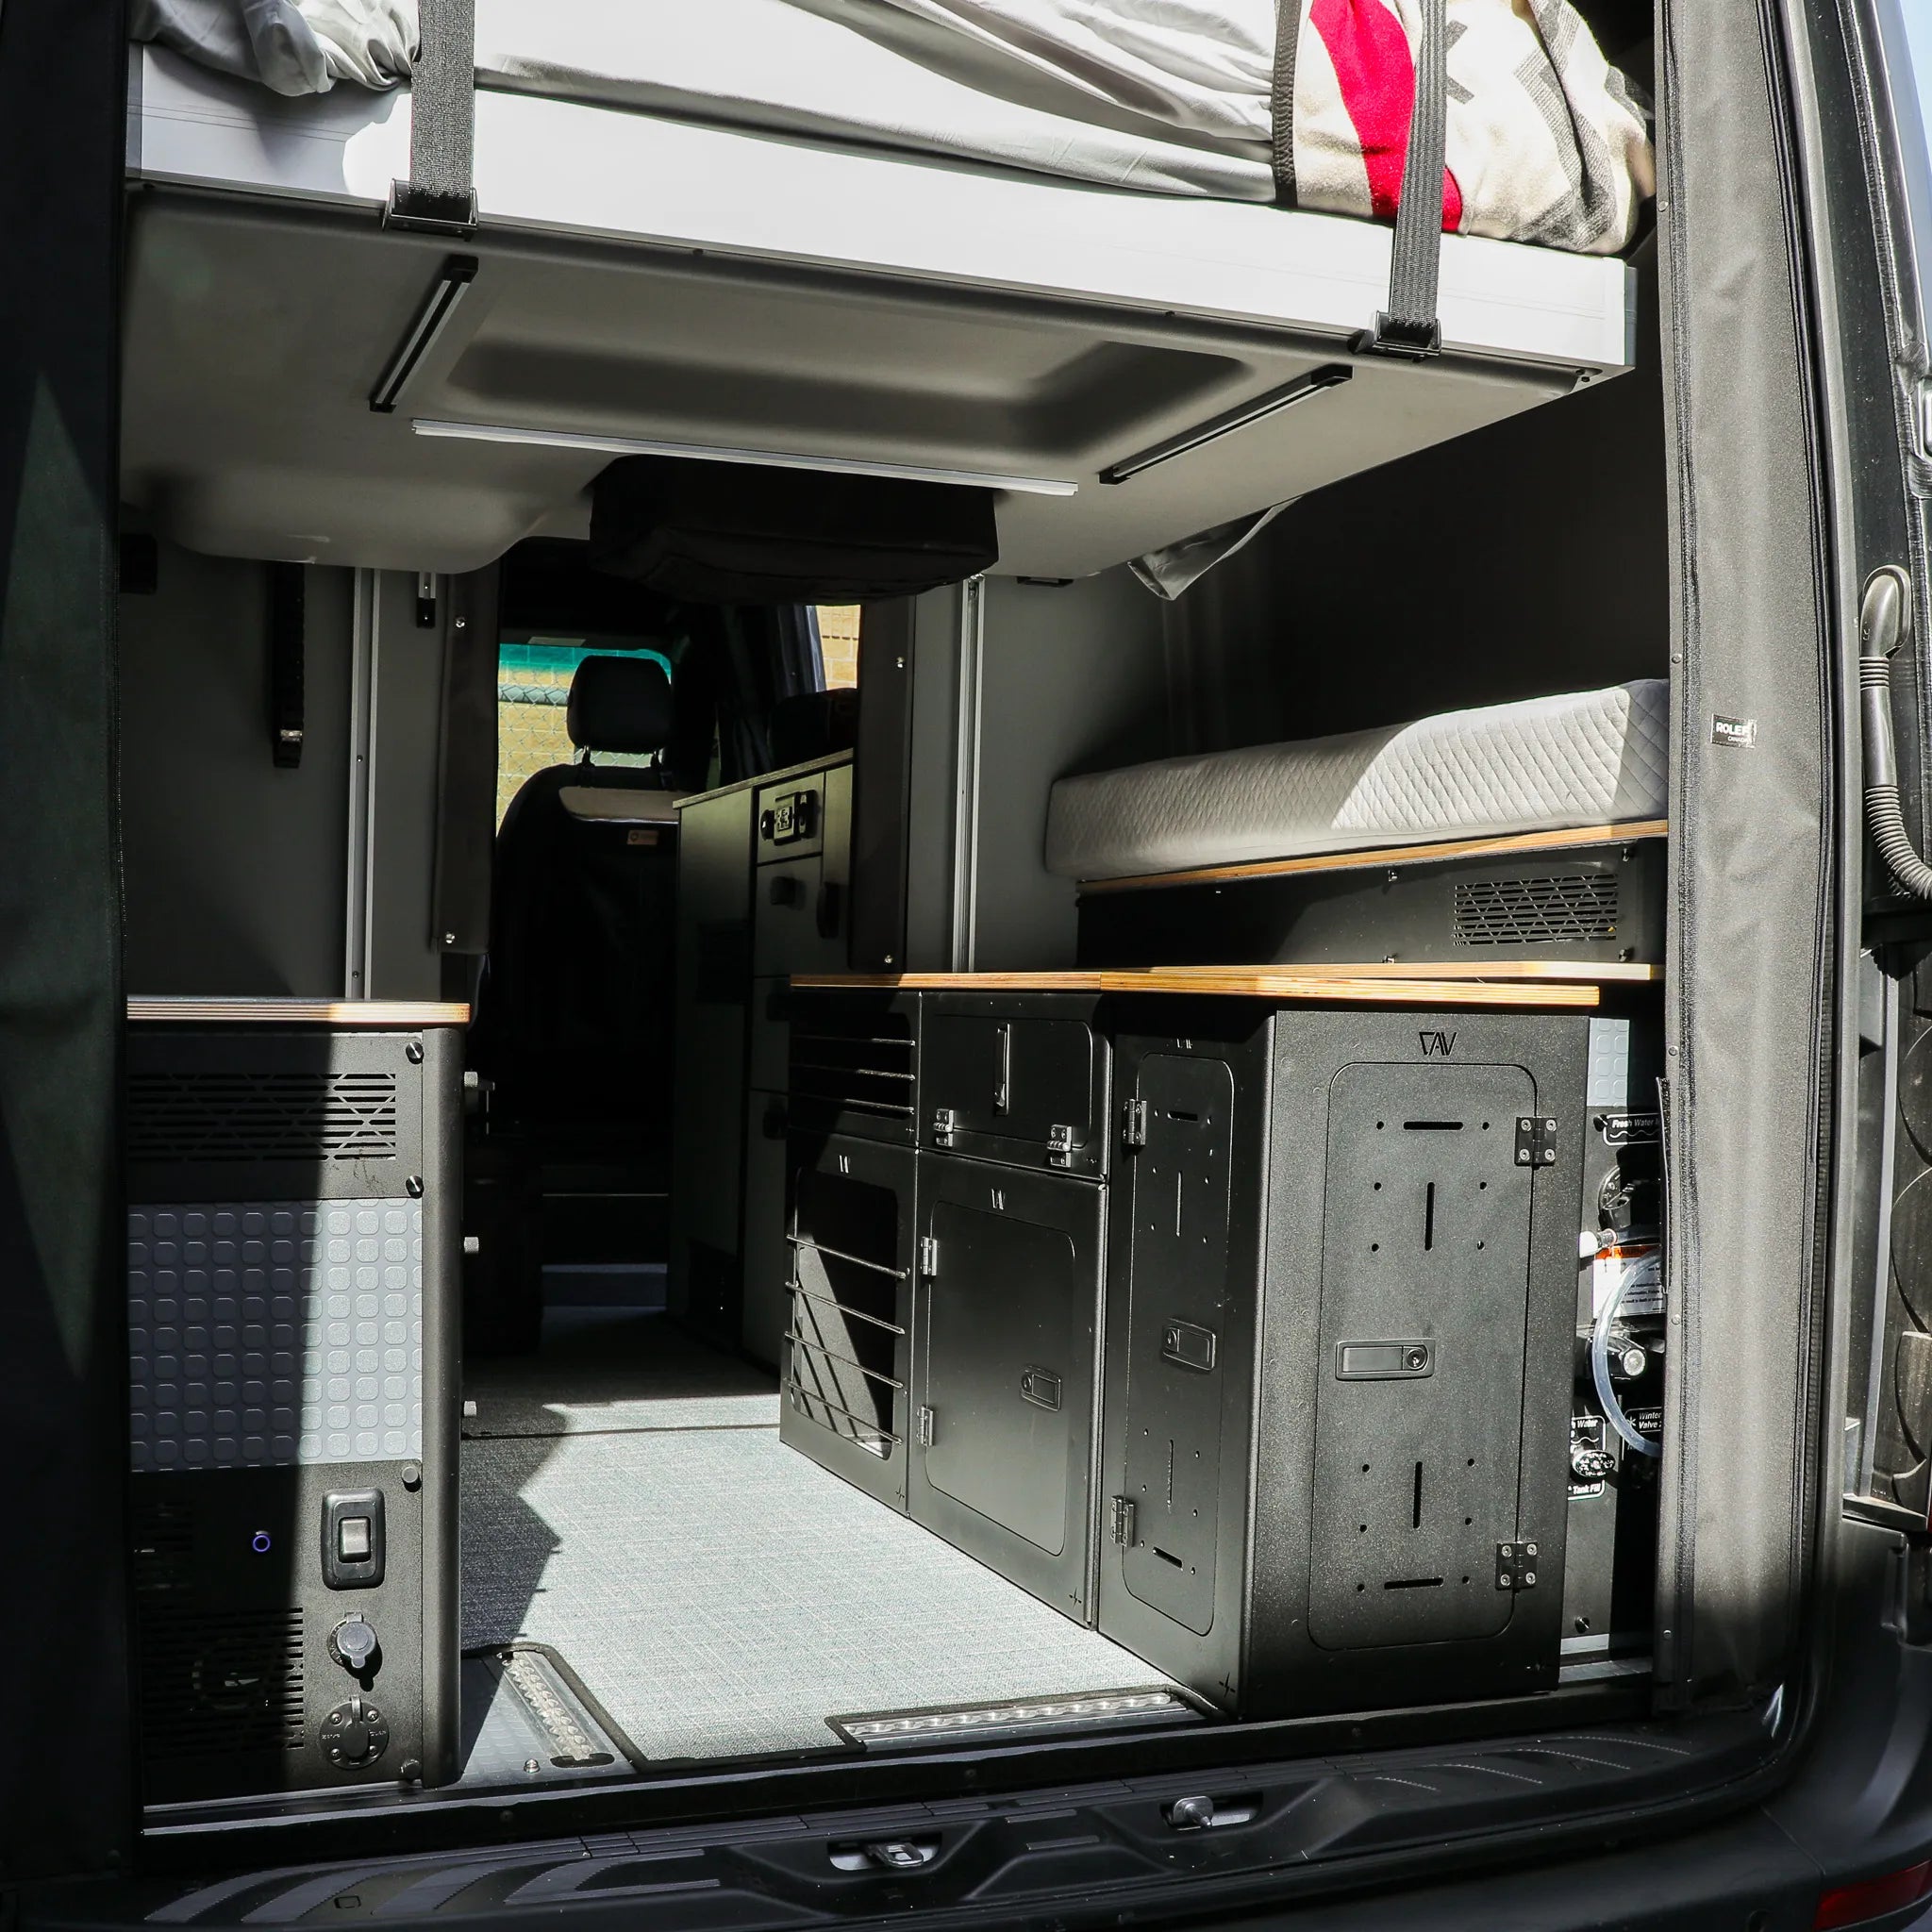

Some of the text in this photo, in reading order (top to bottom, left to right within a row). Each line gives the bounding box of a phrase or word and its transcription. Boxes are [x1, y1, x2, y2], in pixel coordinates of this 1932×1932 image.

[1612, 1119, 1633, 1128] Fresh
[1634, 1118, 1654, 1126] Water
[1576, 1419, 1598, 1428] Water
[1639, 1421, 1658, 1429] Valve
[1573, 1484, 1590, 1494] Tank
